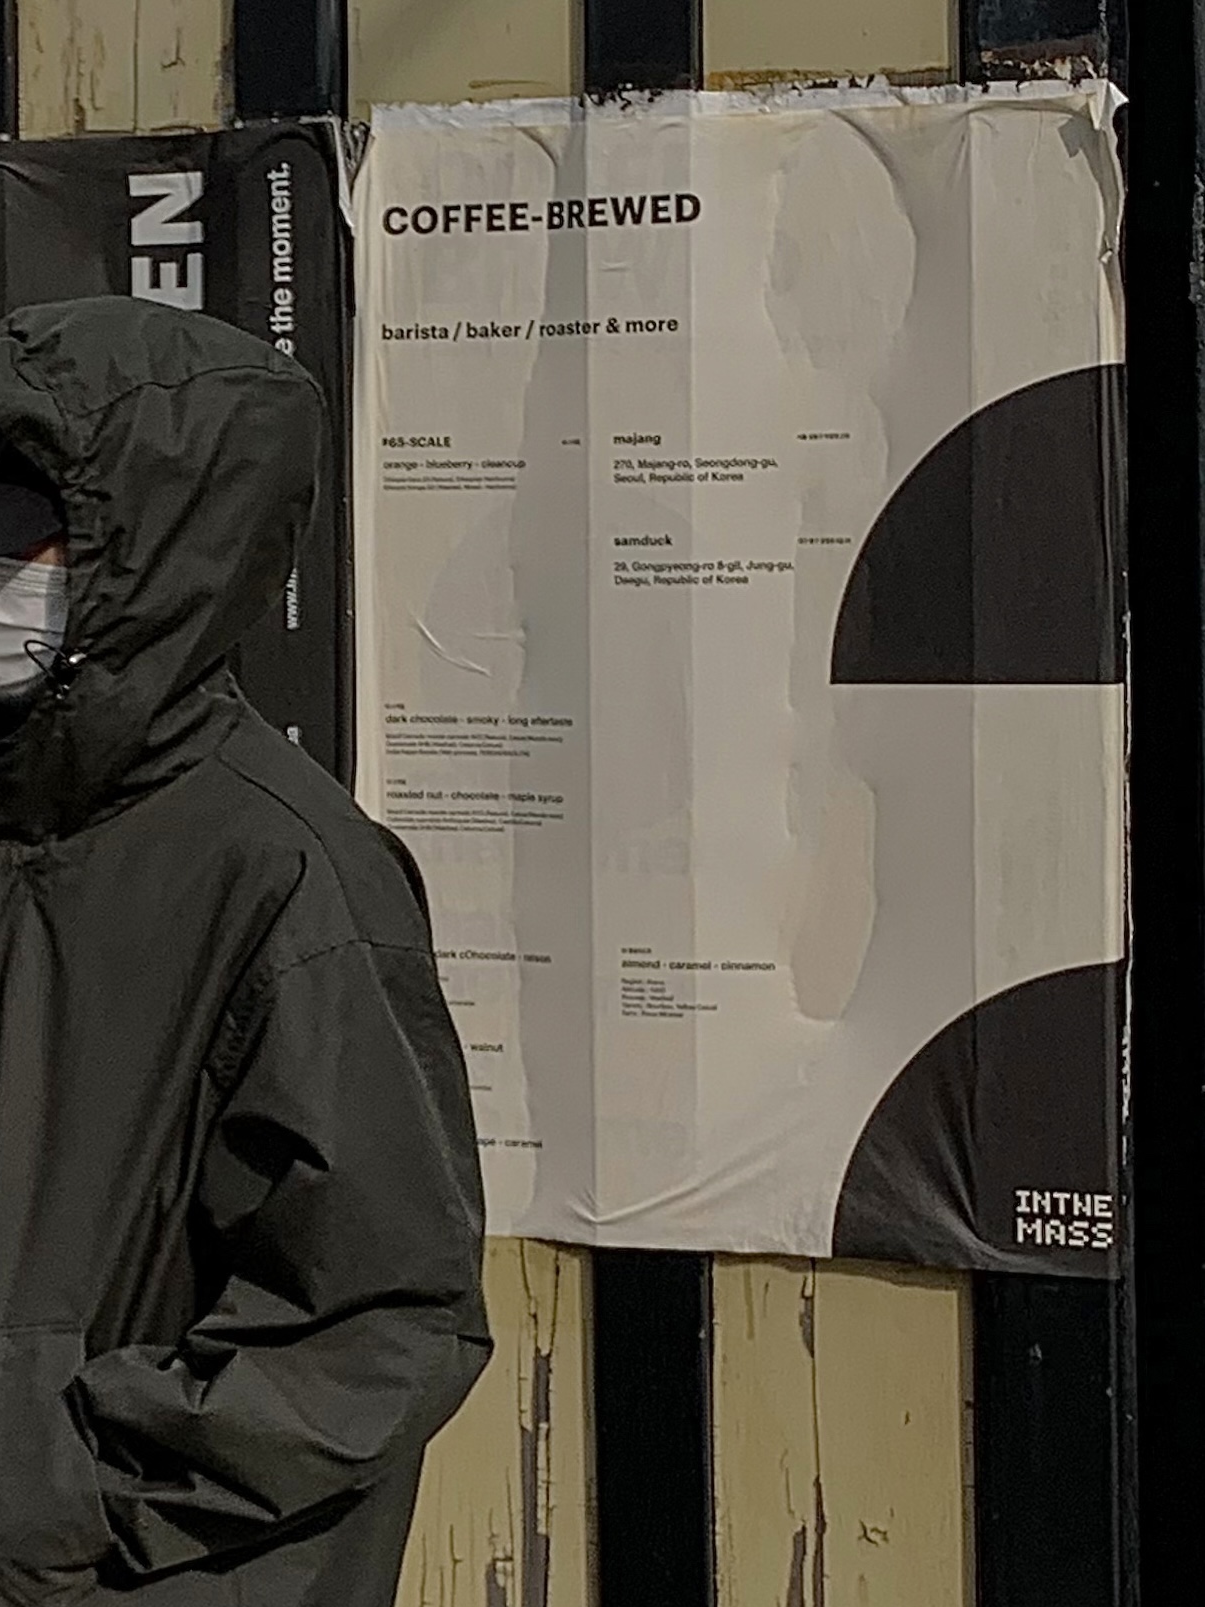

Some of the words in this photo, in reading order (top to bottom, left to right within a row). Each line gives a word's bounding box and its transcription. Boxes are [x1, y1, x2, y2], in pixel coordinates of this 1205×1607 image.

[267, 162, 292, 283] moment.
[382, 194, 701, 235] COFFEE-BREWED
[269, 288, 293, 333] the
[381, 323, 449, 340] barista
[466, 322, 521, 339] baker
[539, 320, 600, 337] roaster
[625, 318, 679, 333] more
[614, 432, 661, 446] majang
[697, 471, 709, 482] of
[711, 471, 744, 482] Korea
[614, 534, 672, 546] samduck
[1015, 1216, 1113, 1249] MASS
